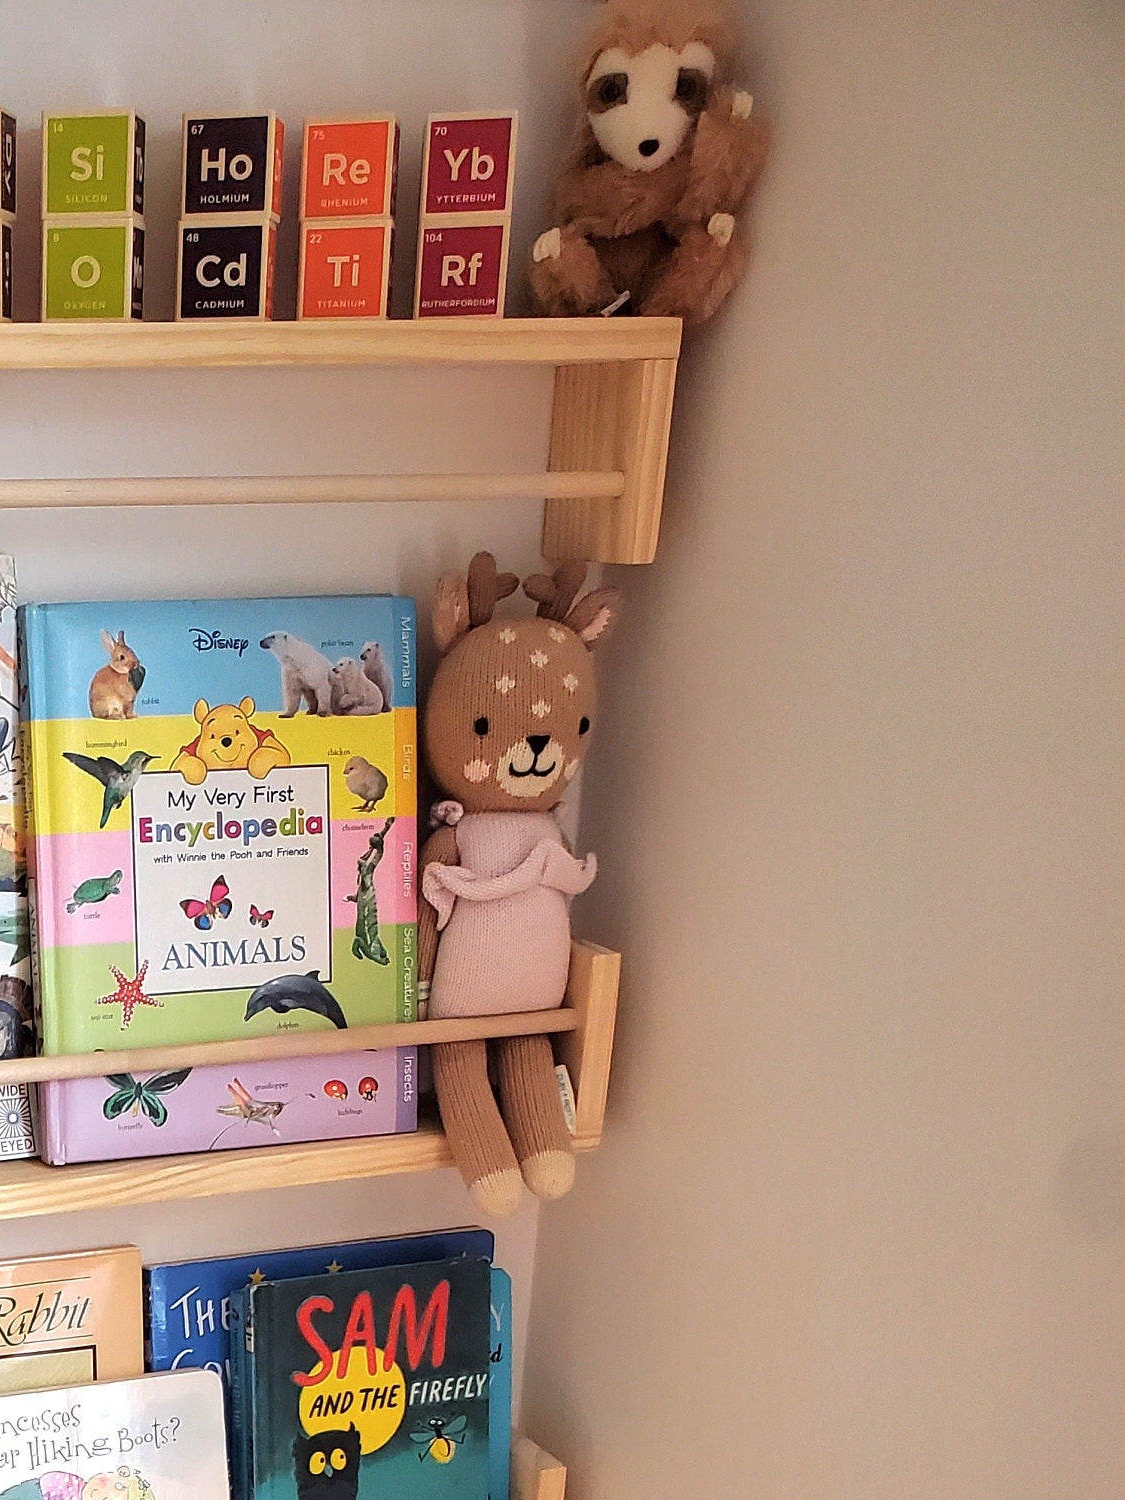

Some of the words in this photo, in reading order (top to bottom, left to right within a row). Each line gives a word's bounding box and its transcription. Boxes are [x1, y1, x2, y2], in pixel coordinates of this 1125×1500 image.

[190, 124, 204, 136] 67
[313, 130, 325, 141] 75
[434, 126, 448, 136] 70
[69, 145, 105, 181] Si
[200, 148, 253, 182] Ho
[322, 153, 371, 186] Re
[444, 147, 495, 181] Yb
[65, 194, 108, 204] SILICON
[200, 193, 250, 204] HOLMIUM
[321, 197, 368, 208] RHENIUM
[436, 193, 496, 204] YTTERBIUM
[52, 232, 60, 243] 8
[186, 233, 200, 243] 48
[309, 234, 322, 244] 22
[425, 233, 443, 243] 104
[70, 255, 101, 289] O
[196, 253, 247, 287] Cd
[327, 254, 360, 287] Ti
[441, 252, 483, 287] Rf
[64, 301, 106, 310] OXYGEN
[195, 299, 245, 310] CADMIUM
[317, 299, 366, 309] TITANIUM
[421, 298, 496, 309] RUTHERFORDIUM
[401, 616, 412, 688] Mammals
[327, 747, 351, 756] chicken
[402, 744, 412, 780] Birds
[167, 790, 197, 811] My
[204, 788, 246, 809] Very
[253, 785, 295, 804] First
[139, 807, 324, 847] Encyclopedia
[154, 854, 173, 864] with
[177, 853, 207, 863] Winnie
[211, 851, 225, 861] the
[230, 850, 253, 860] Pooh
[256, 848, 273, 858] and
[276, 847, 309, 857] Friends
[401, 842, 413, 898] Reptiles
[161, 935, 307, 971] ANIMALS
[403, 927, 414, 956] Sea
[403, 1056, 415, 1103] Insects
[0, 1137, 34, 1154] EYED
[291, 1279, 451, 1387] SAM
[309, 1388, 354, 1419] AND
[359, 1384, 401, 1413] THE
[409, 1373, 488, 1406] FIREFLY
[26, 1435, 112, 1471] Hiking
[117, 1417, 181, 1454] Boots?
